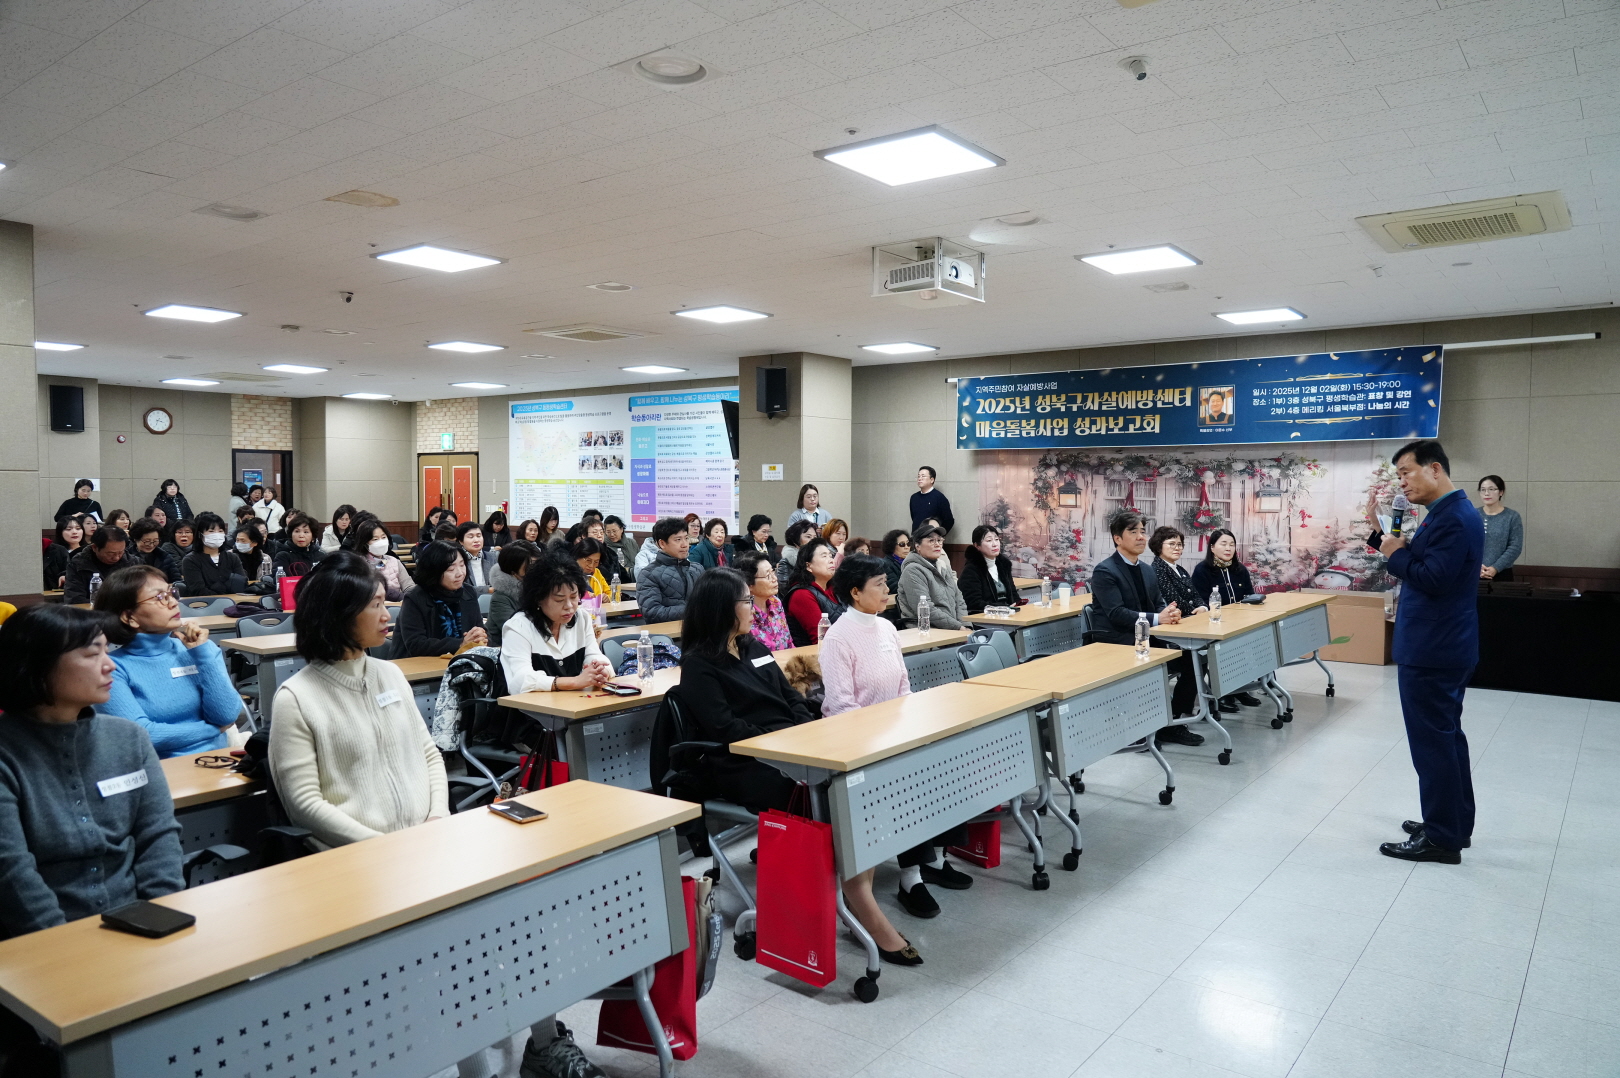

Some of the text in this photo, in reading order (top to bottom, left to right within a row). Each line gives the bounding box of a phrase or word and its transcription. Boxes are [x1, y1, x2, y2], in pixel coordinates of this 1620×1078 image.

[975, 381, 1058, 394] 지역주민참여 자살예방사업
[1252, 388, 1267, 397] 일시
[1272, 386, 1300, 396] 2025년
[1301, 385, 1318, 394] 12월
[1352, 380, 1401, 391] 15:30-19:00
[976, 387, 1192, 414] 2025년 성북구자살예방센터
[1252, 398, 1267, 406] 장소
[1287, 396, 1300, 405] 3층
[1301, 395, 1324, 404] 성북구
[1396, 390, 1412, 398] 강연
[1287, 406, 1300, 415] 4층
[1394, 400, 1410, 409] 시간
[975, 414, 1160, 438] 마음돌봄사업 성과보고회
